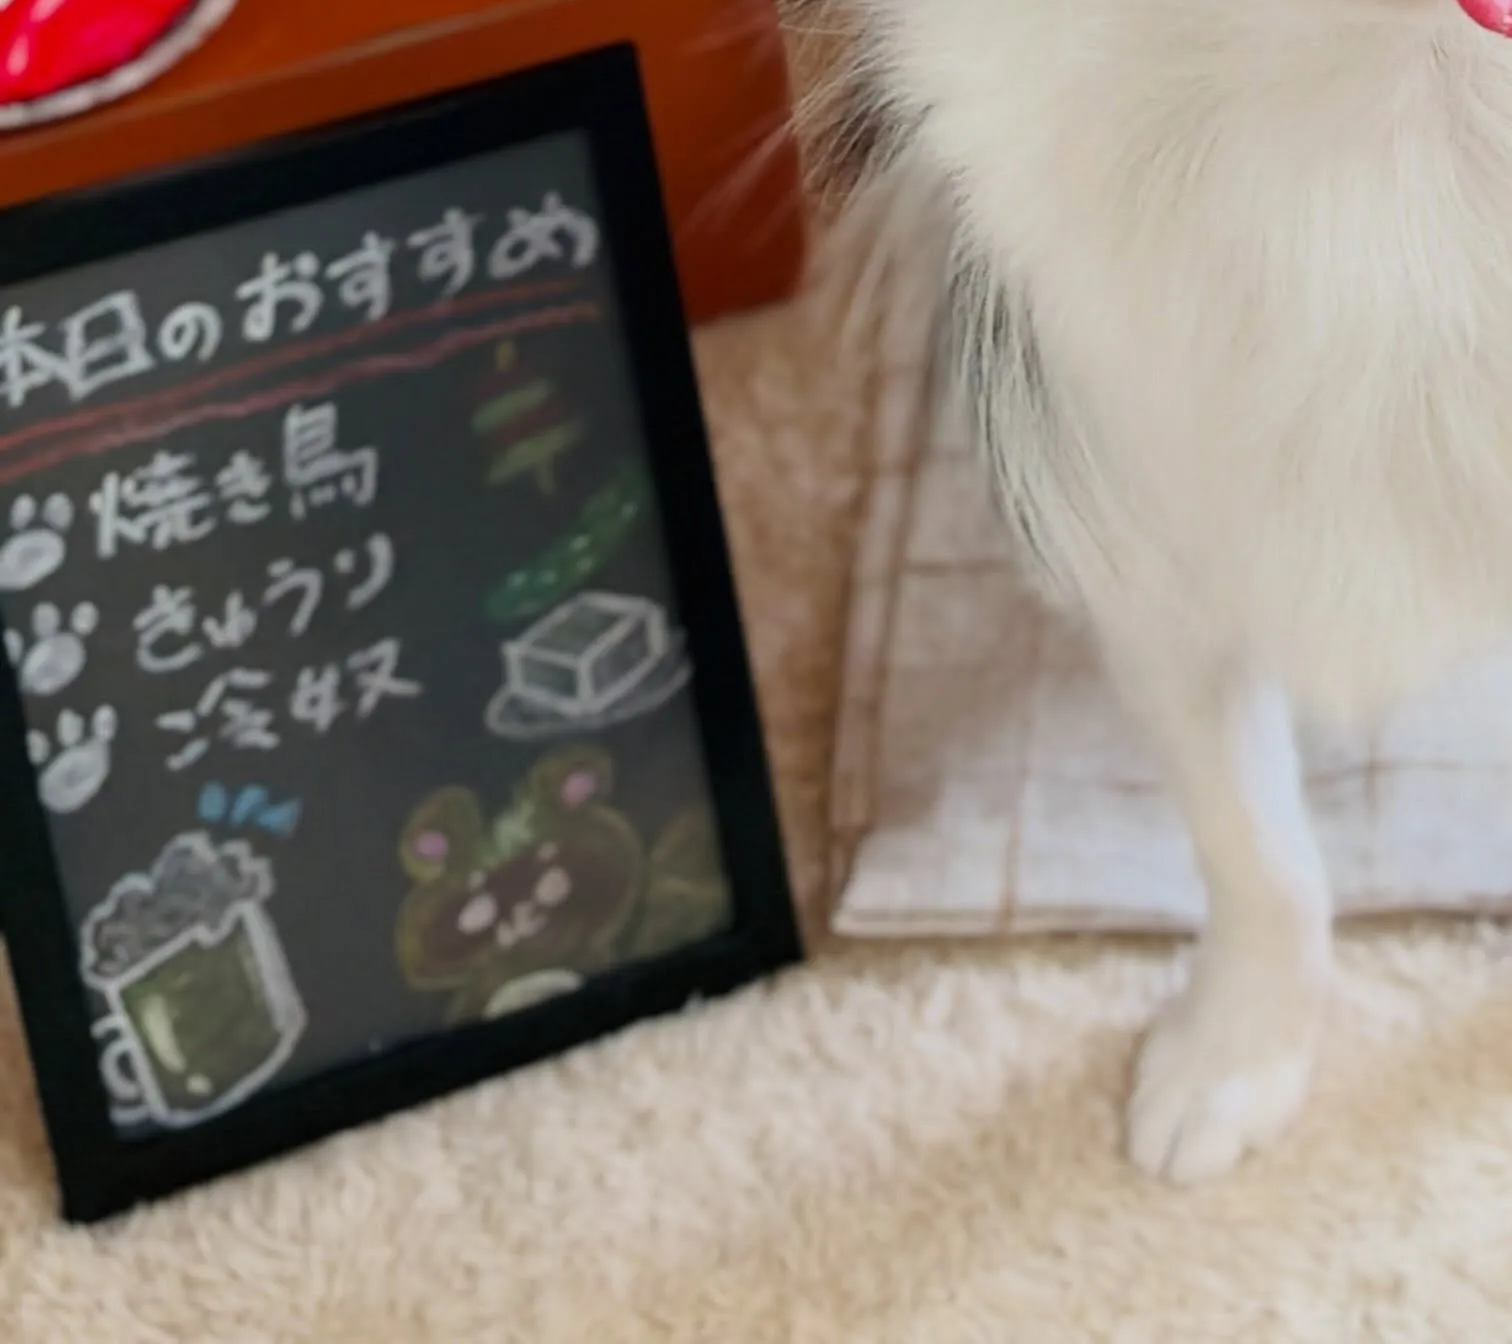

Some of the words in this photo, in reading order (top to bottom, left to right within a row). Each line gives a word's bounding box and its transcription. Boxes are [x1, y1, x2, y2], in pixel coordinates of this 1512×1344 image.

[0, 191, 600, 408] 本日のおすすめ
[89, 402, 380, 559] 焼き鳥
[132, 531, 395, 674] きゅうり
[155, 637, 424, 771] 冷奴
